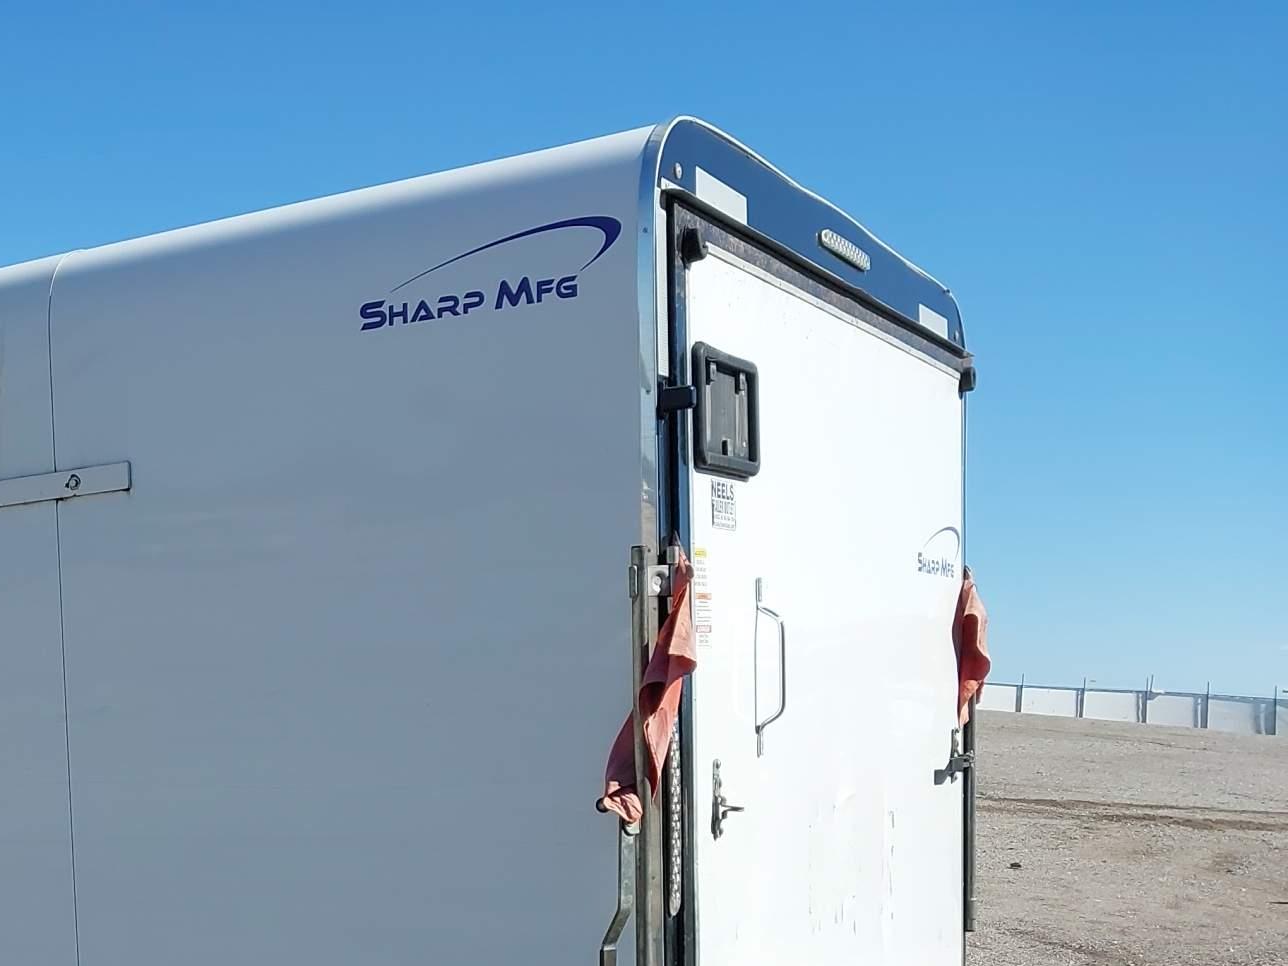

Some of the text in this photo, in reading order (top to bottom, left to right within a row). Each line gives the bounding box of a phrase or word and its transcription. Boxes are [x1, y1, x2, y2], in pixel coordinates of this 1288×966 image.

[359, 275, 579, 332] SHARP MFG
[711, 480, 735, 502] NEELS
